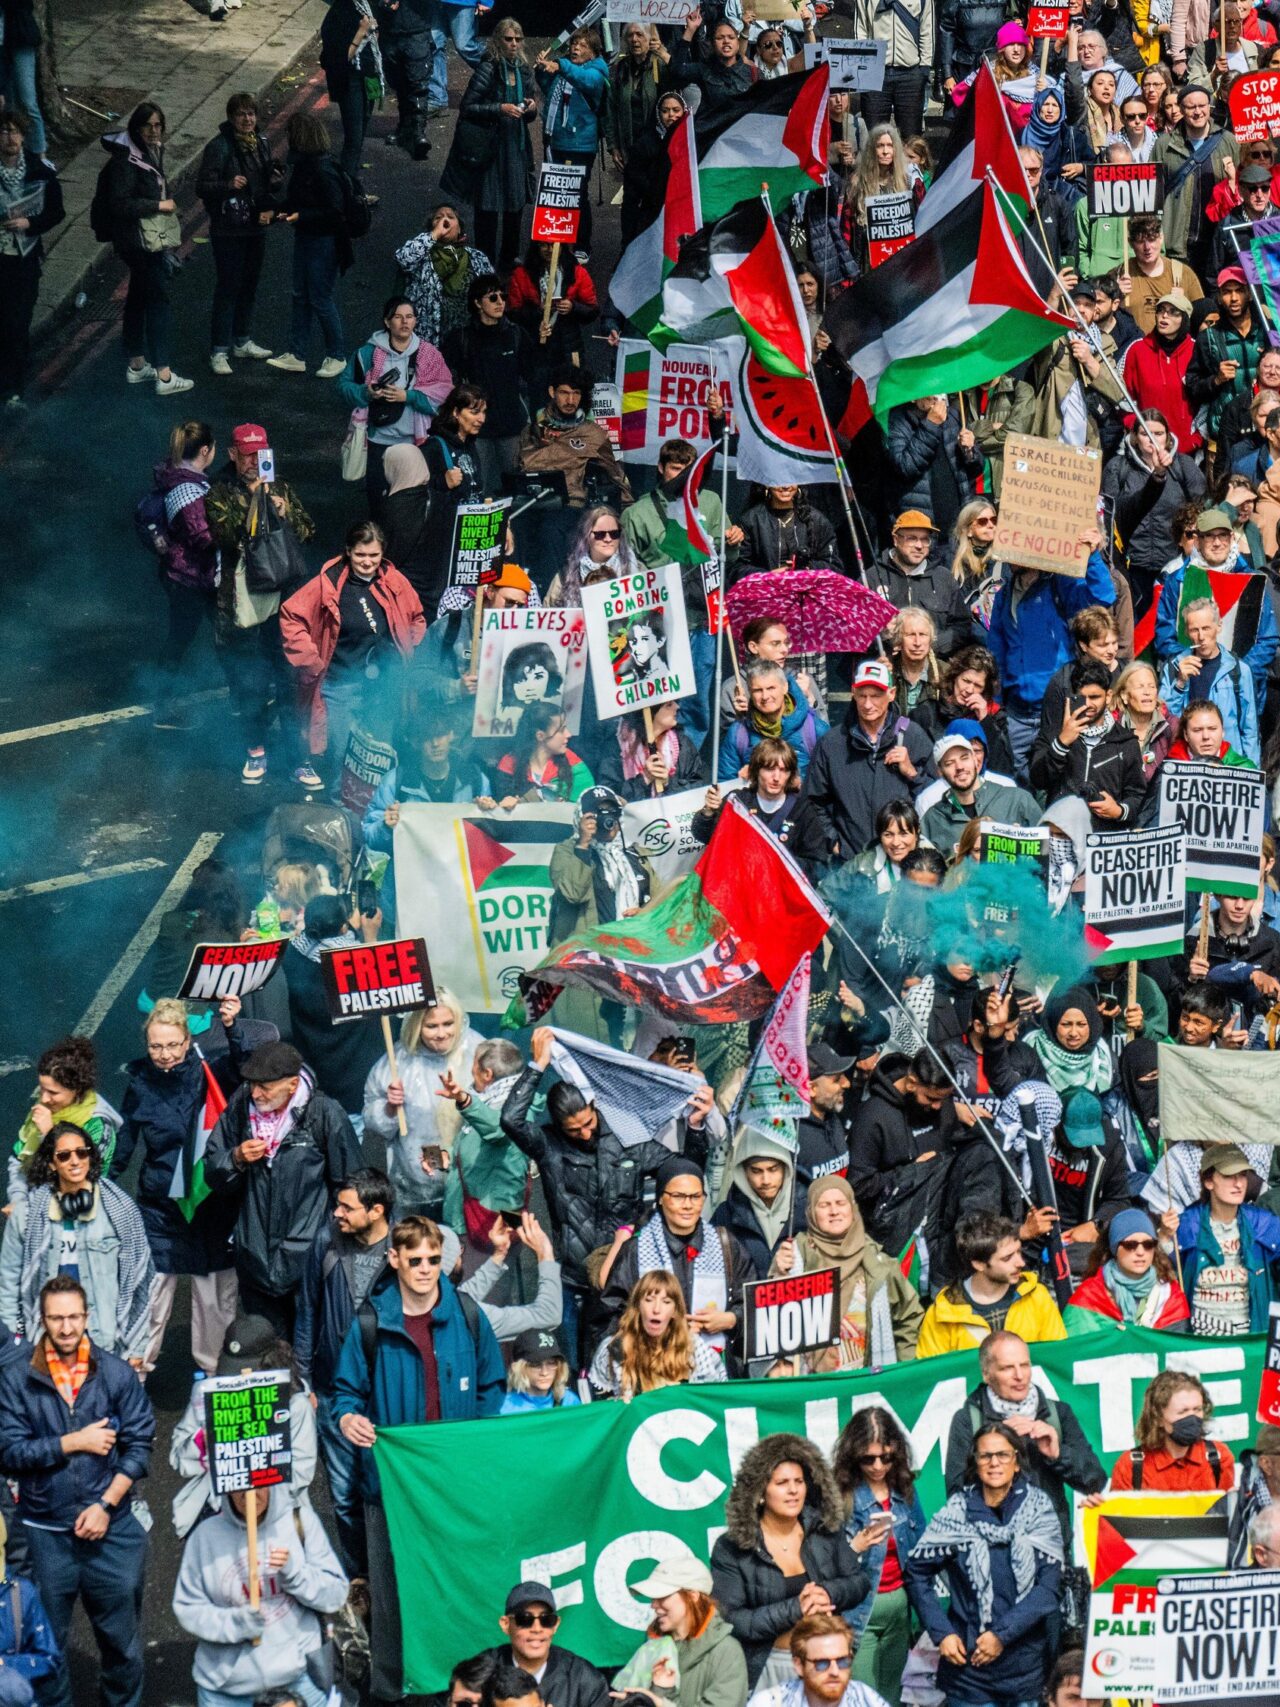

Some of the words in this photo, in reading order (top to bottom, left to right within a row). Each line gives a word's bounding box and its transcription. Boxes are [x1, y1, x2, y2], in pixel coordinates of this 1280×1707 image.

[639, 1, 689, 20] WORLD
[1242, 77, 1278, 96] STOP
[1256, 94, 1273, 104] the
[544, 174, 582, 191] FREEDOM
[1094, 166, 1157, 182] CEASEFIRE
[538, 190, 581, 208] PALESTINE
[1094, 179, 1157, 214] NOW
[1009, 445, 1058, 466] ISRAEL
[1059, 455, 1095, 473] KILLS
[1050, 468, 1096, 487] CHILDREN
[1054, 488, 1079, 500] CALL
[1002, 511, 1022, 525] WE
[1025, 515, 1058, 530] CALL
[1064, 522, 1080, 534] IT
[998, 530, 1083, 560] GENOCIDE
[610, 572, 657, 601] STOP
[603, 590, 669, 619] BOMBING
[486, 611, 519, 631] ALL
[526, 611, 567, 631] EYES
[561, 632, 585, 649] ON
[616, 675, 681, 707] CHILDREN
[1165, 778, 1261, 809] CEASEFIRE
[643, 832, 669, 846] PSC
[1091, 839, 1182, 875] CEASEFIRE
[1101, 867, 1175, 909] NOW!
[1088, 912, 1102, 921] FREE
[1103, 909, 1134, 919] PALESTINE
[1139, 905, 1150, 914] END
[1151, 899, 1183, 911] APARTHEID
[202, 942, 282, 966] CEASEFIRE
[189, 958, 278, 999] NOW
[331, 941, 422, 995] FREE
[340, 982, 426, 1014] PALESTINE
[755, 1272, 834, 1308] CEASEFIRE
[755, 1292, 834, 1355] NOW
[212, 1389, 250, 1410] FROM
[253, 1386, 279, 1406] THE
[212, 1406, 252, 1427] RIVER
[254, 1404, 273, 1423] TO
[213, 1425, 240, 1444] THE
[241, 1422, 267, 1440] SEA
[214, 1433, 285, 1460] PALESTINE
[214, 1457, 249, 1476] WILL
[250, 1453, 268, 1471] BE
[1176, 1630, 1278, 1685] NOW!
[1157, 1687, 1177, 1701] FREE
[1178, 1683, 1220, 1698] PALESTINE
[1227, 1681, 1245, 1695] END
